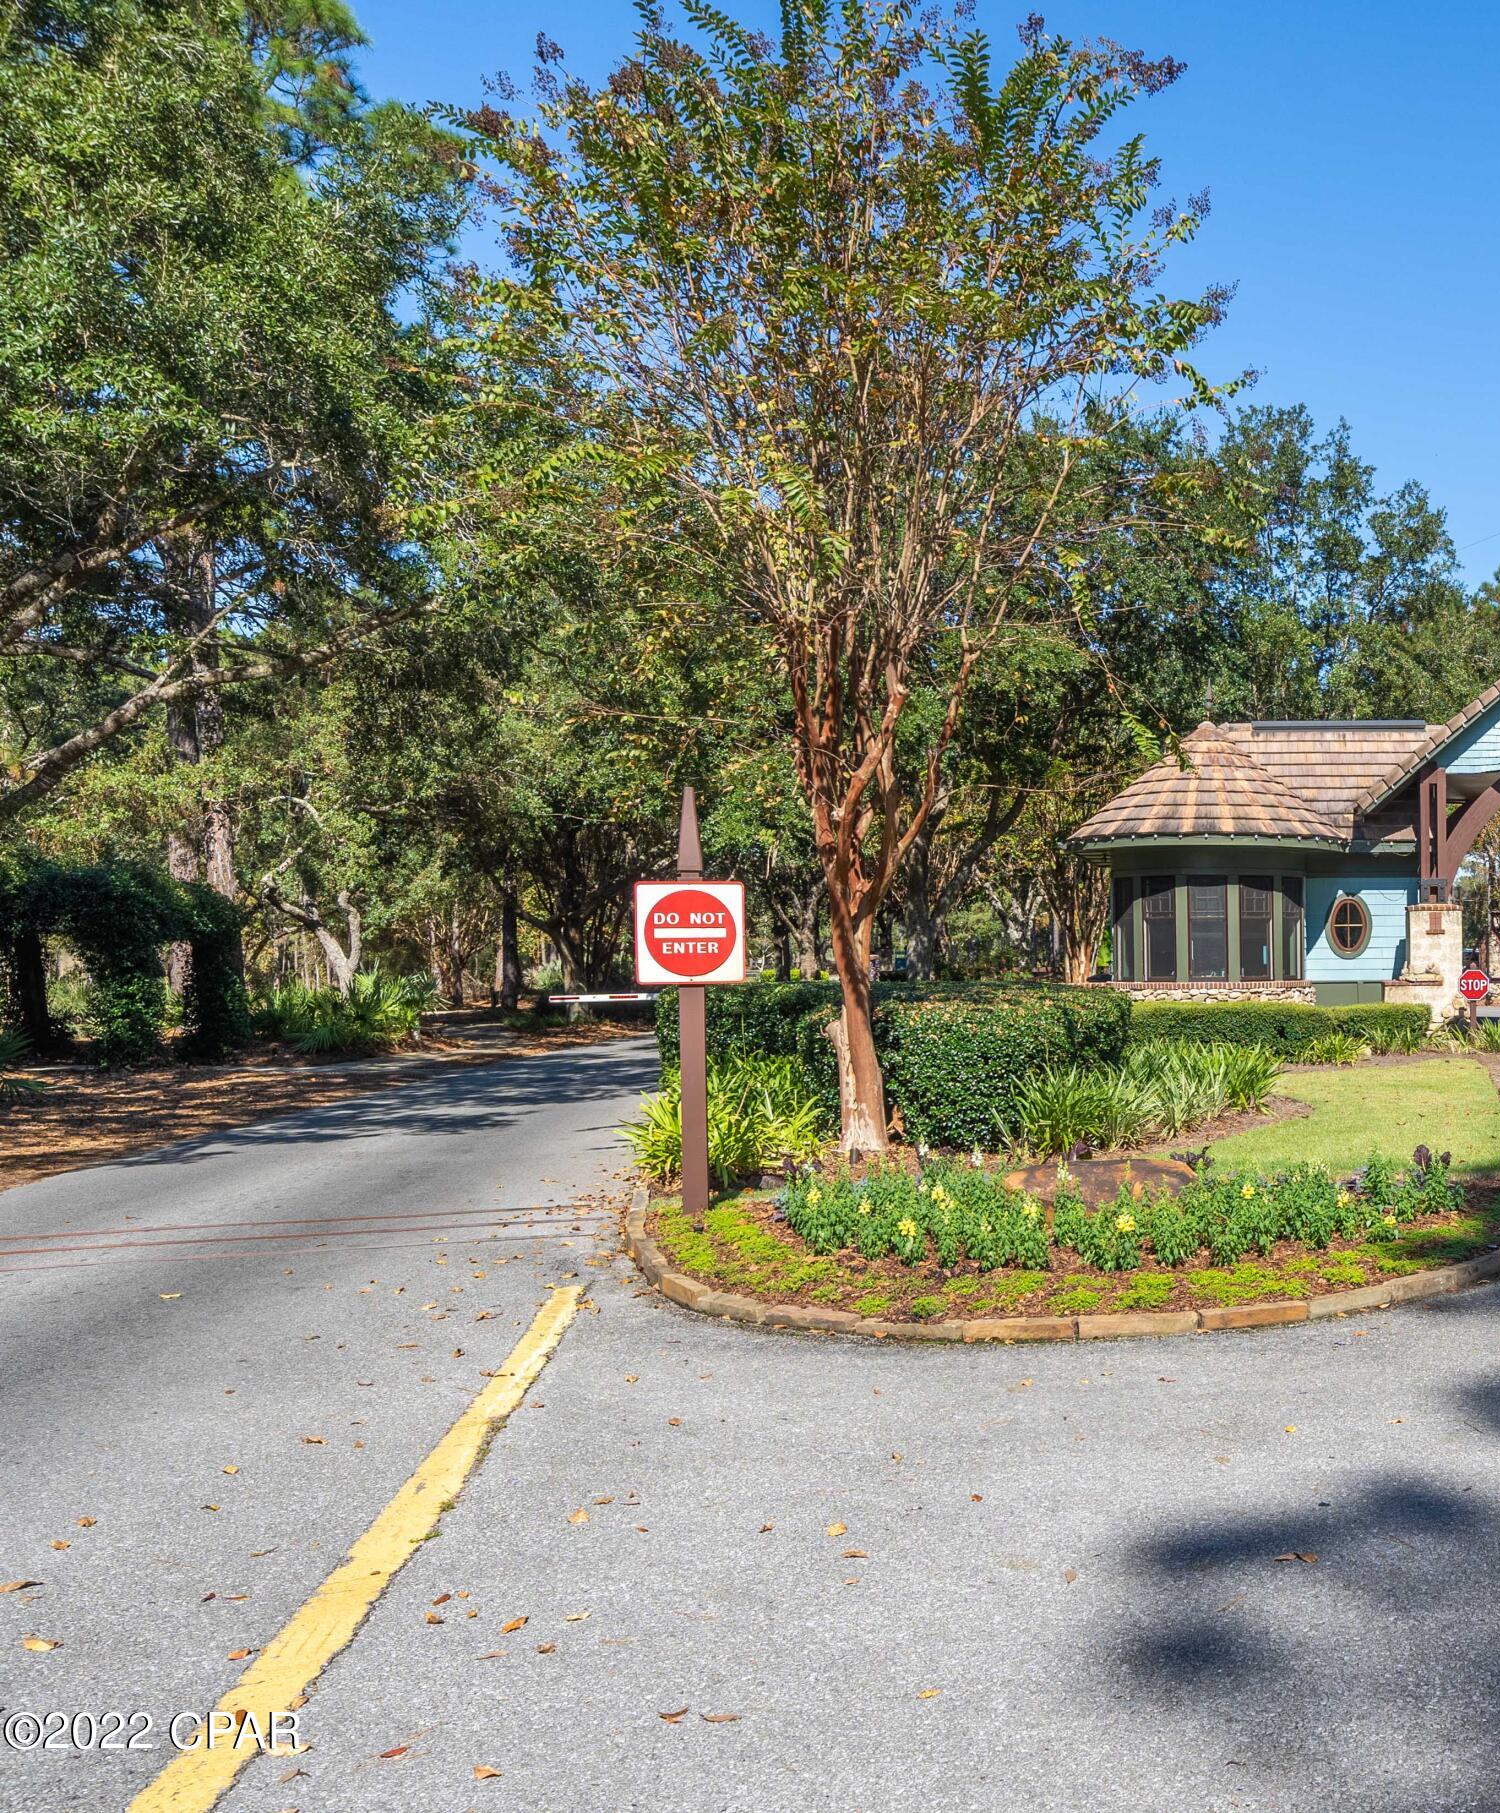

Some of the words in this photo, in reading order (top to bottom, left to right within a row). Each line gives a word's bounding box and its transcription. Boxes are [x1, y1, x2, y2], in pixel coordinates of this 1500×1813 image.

[653, 912, 680, 925] DO
[689, 912, 726, 925] NOT
[662, 941, 719, 954] ENTER
[1460, 979, 1487, 991] STOP
